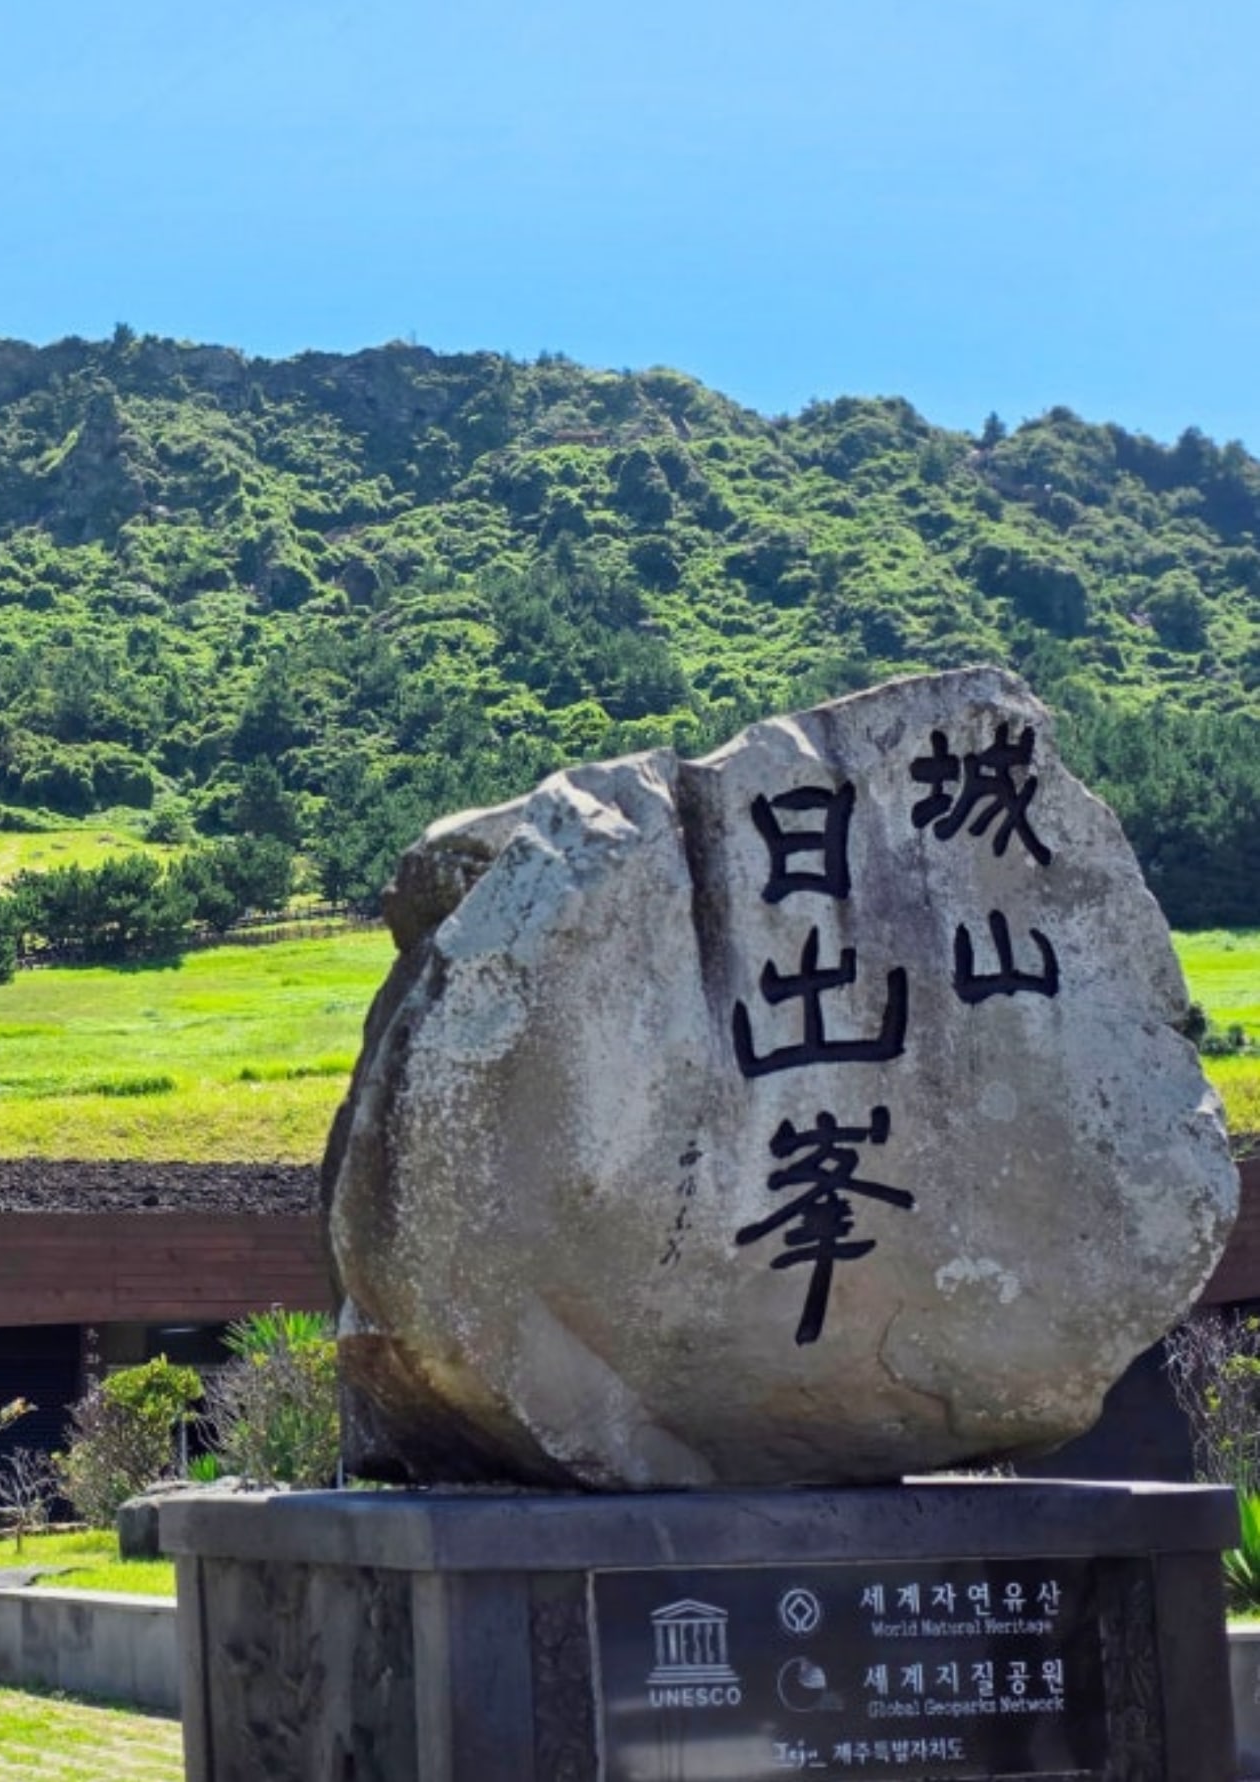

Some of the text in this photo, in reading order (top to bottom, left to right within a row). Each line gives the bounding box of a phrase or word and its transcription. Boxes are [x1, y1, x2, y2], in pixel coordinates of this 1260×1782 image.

[910, 722, 1059, 1003] 城山
[860, 1579, 1062, 1617] 세계자연유산
[871, 1617, 1054, 1638] World Natural Heritage
[863, 1658, 1065, 1698] 세계지질공원
[648, 1685, 743, 1709] UNESCO
[867, 1697, 1065, 1718] Global Geoparks Network
